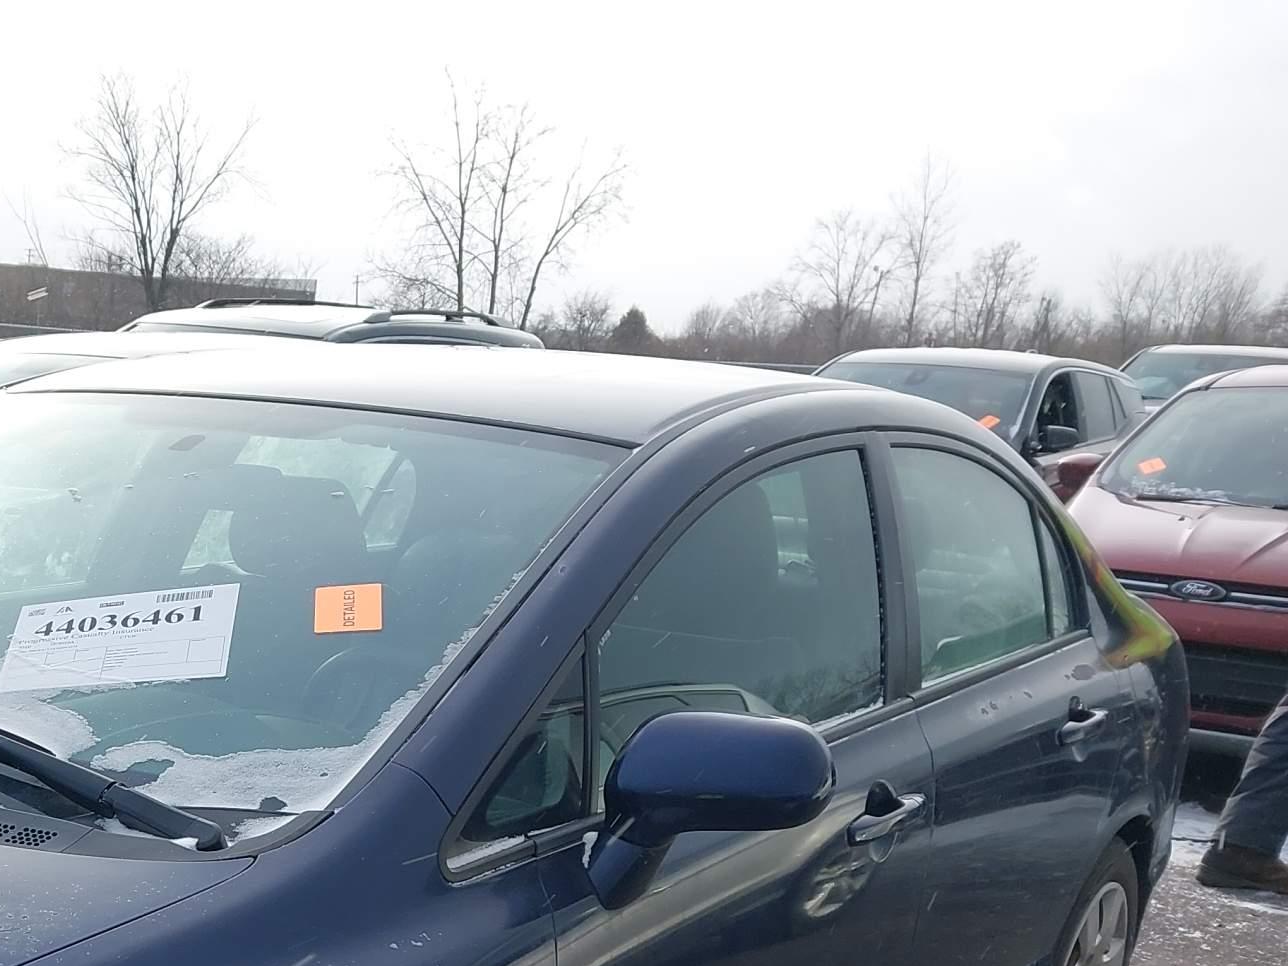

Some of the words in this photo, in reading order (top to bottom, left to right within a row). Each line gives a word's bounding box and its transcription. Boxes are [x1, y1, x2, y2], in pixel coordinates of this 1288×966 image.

[1182, 582, 1213, 597] Ford
[343, 589, 356, 627] DETAILED
[34, 604, 203, 637] 44036461
[112, 626, 155, 636] Insurance
